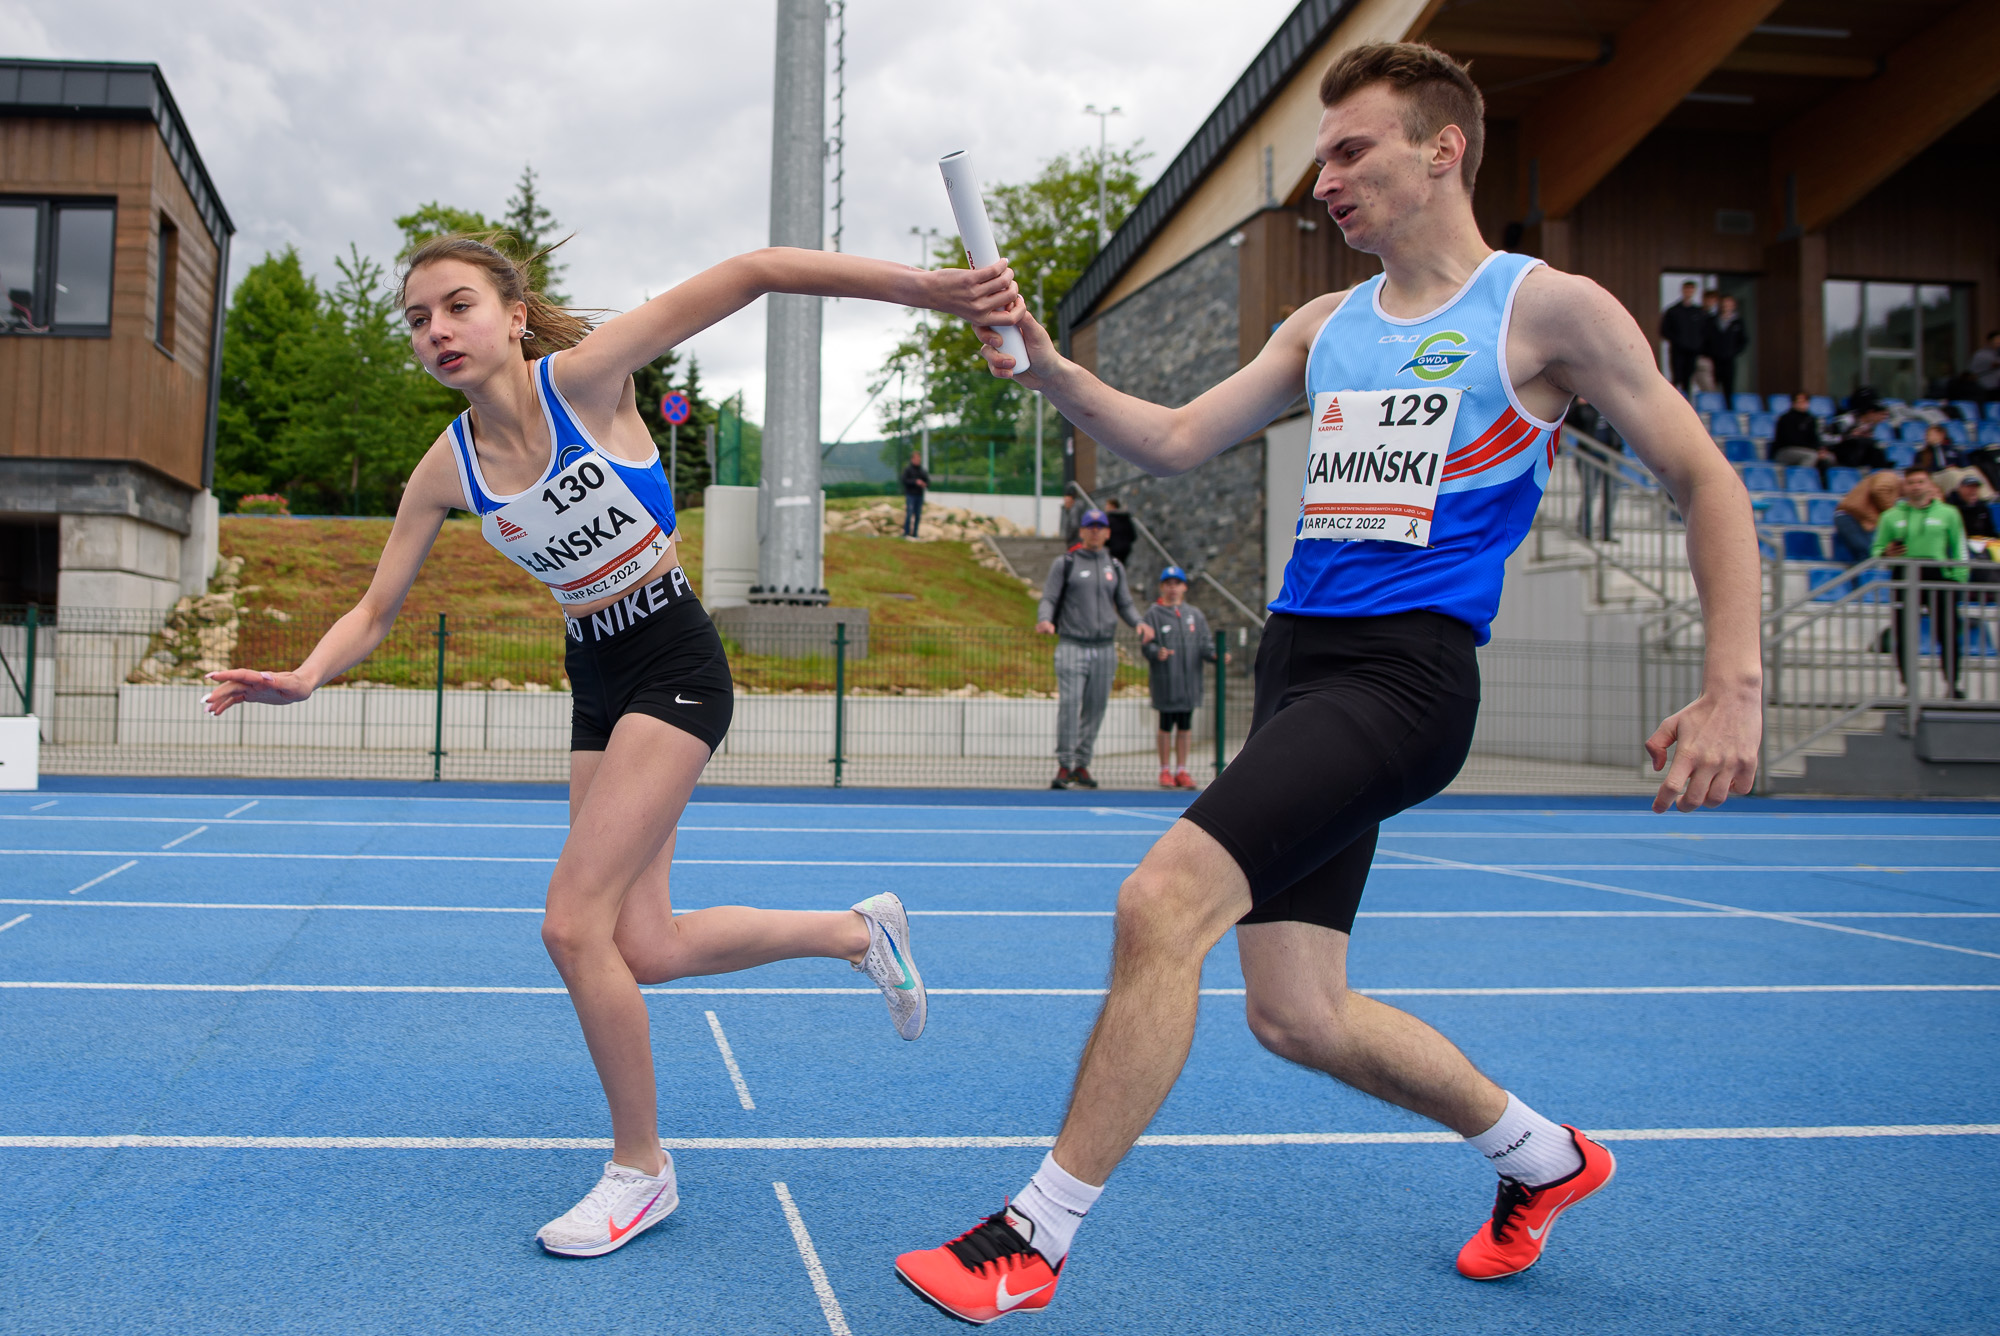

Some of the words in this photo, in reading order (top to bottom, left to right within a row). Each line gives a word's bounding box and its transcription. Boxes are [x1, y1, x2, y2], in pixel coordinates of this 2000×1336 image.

[966, 250, 976, 271] POLA
[1417, 356, 1449, 365] GWDA
[1378, 393, 1448, 427] 129
[1317, 425, 1344, 433] KARPACZ
[1307, 444, 1439, 487] KAMIŃSKI
[542, 461, 605, 516] 130
[505, 531, 529, 543] KARPACZ
[517, 506, 638, 573] ŁAŃSKA
[1305, 517, 1354, 529] KARPACZ
[1355, 518, 1387, 530] 2022
[561, 581, 611, 601] KARPACZ
[610, 560, 641, 585] 2022
[591, 576, 669, 642] NIKE
